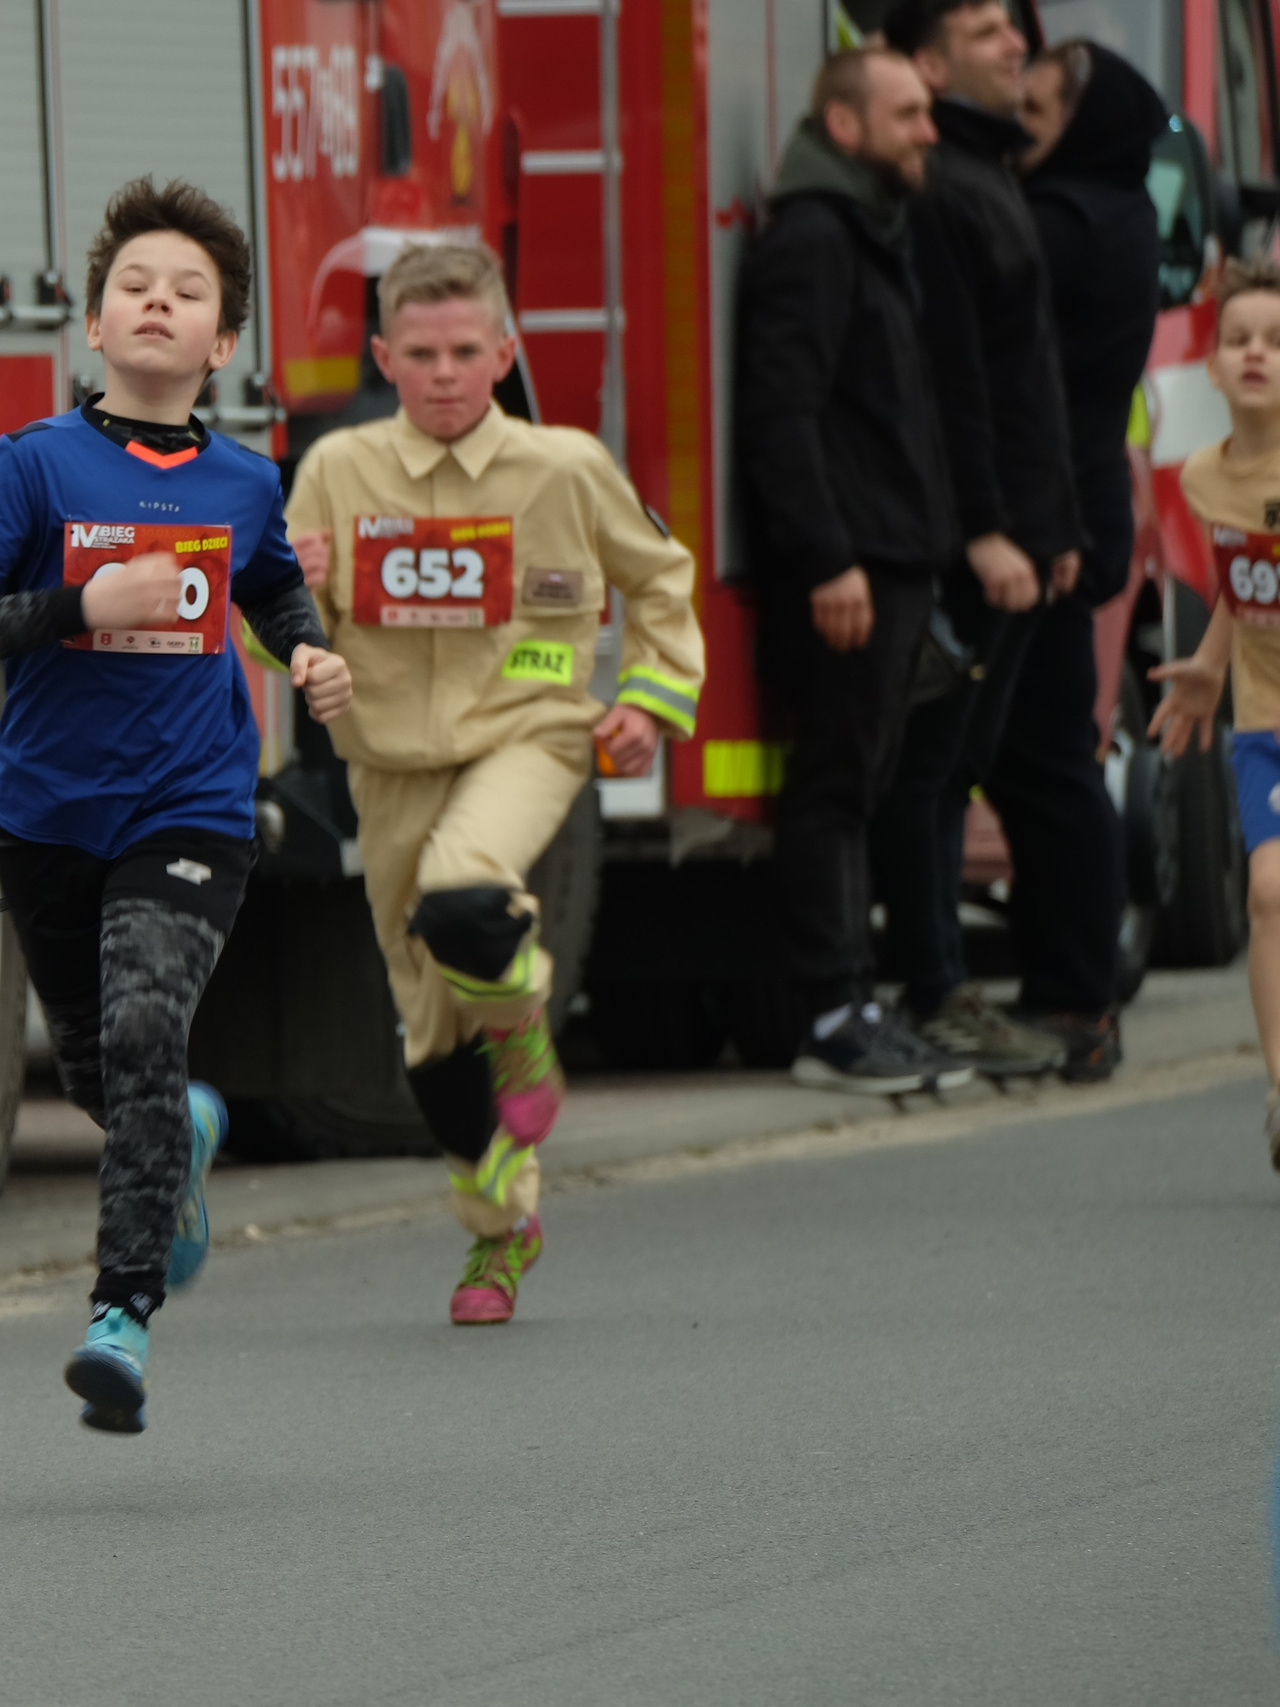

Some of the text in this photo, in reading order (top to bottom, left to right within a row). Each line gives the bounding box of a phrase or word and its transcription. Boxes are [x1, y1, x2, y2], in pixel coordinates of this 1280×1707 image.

[99, 526, 135, 538] BIEG
[175, 536, 228, 554] BIEG DZIECI
[381, 548, 484, 599] 652
[1229, 555, 1280, 605] 69
